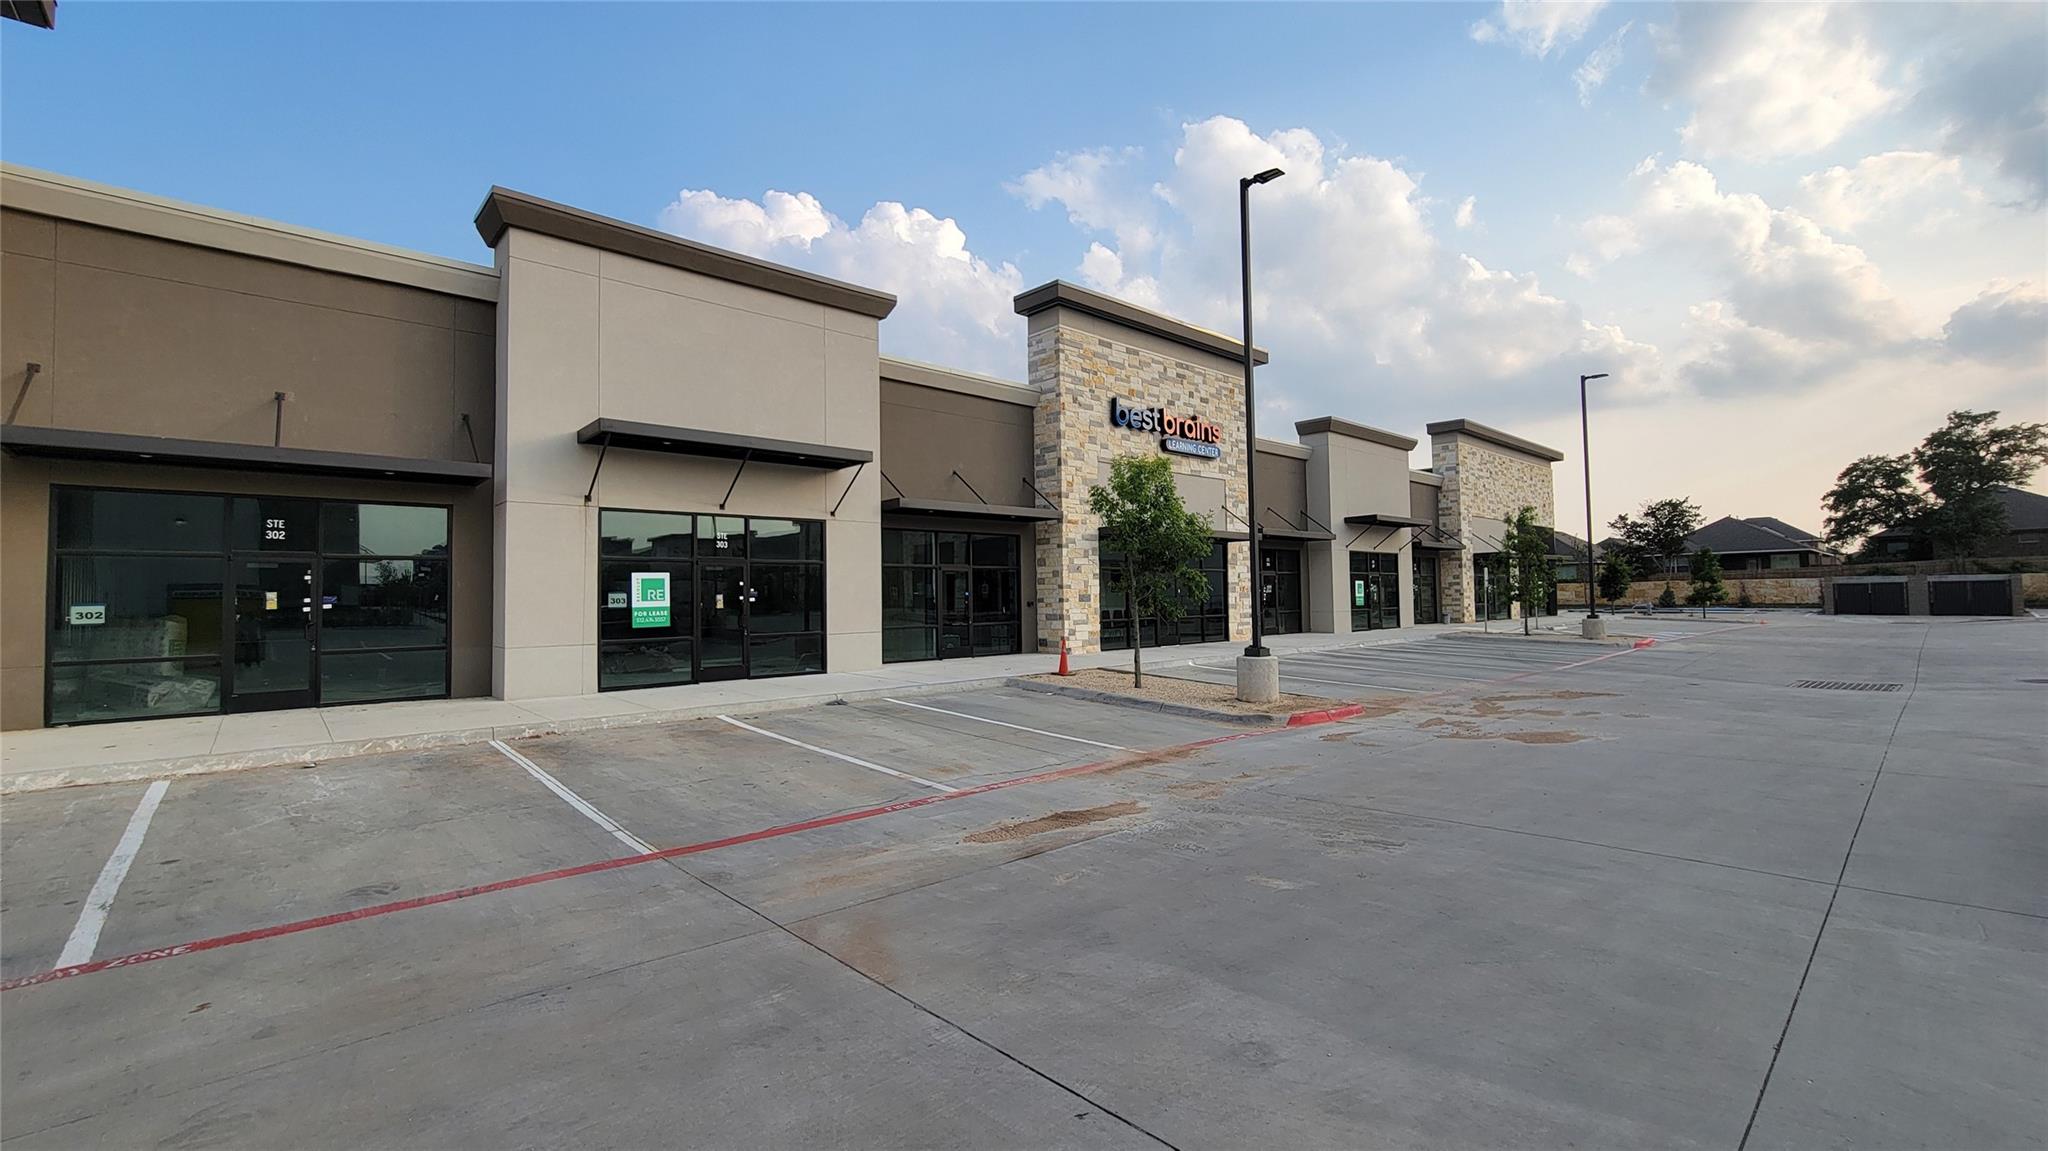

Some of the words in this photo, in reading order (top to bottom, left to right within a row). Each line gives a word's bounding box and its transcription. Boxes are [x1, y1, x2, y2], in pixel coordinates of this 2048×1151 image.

[1113, 397, 1161, 431] best
[1163, 408, 1221, 443] brains
[1167, 438, 1197, 453] LEARNING
[1197, 444, 1219, 457] CENTER
[266, 519, 286, 528] STE
[265, 530, 286, 540] 302
[716, 532, 728, 540] STE
[715, 541, 728, 549] 303
[647, 589, 665, 601] RE
[610, 597, 626, 605] 303
[75, 611, 104, 620] 302
[105, 945, 194, 969] ZONE
